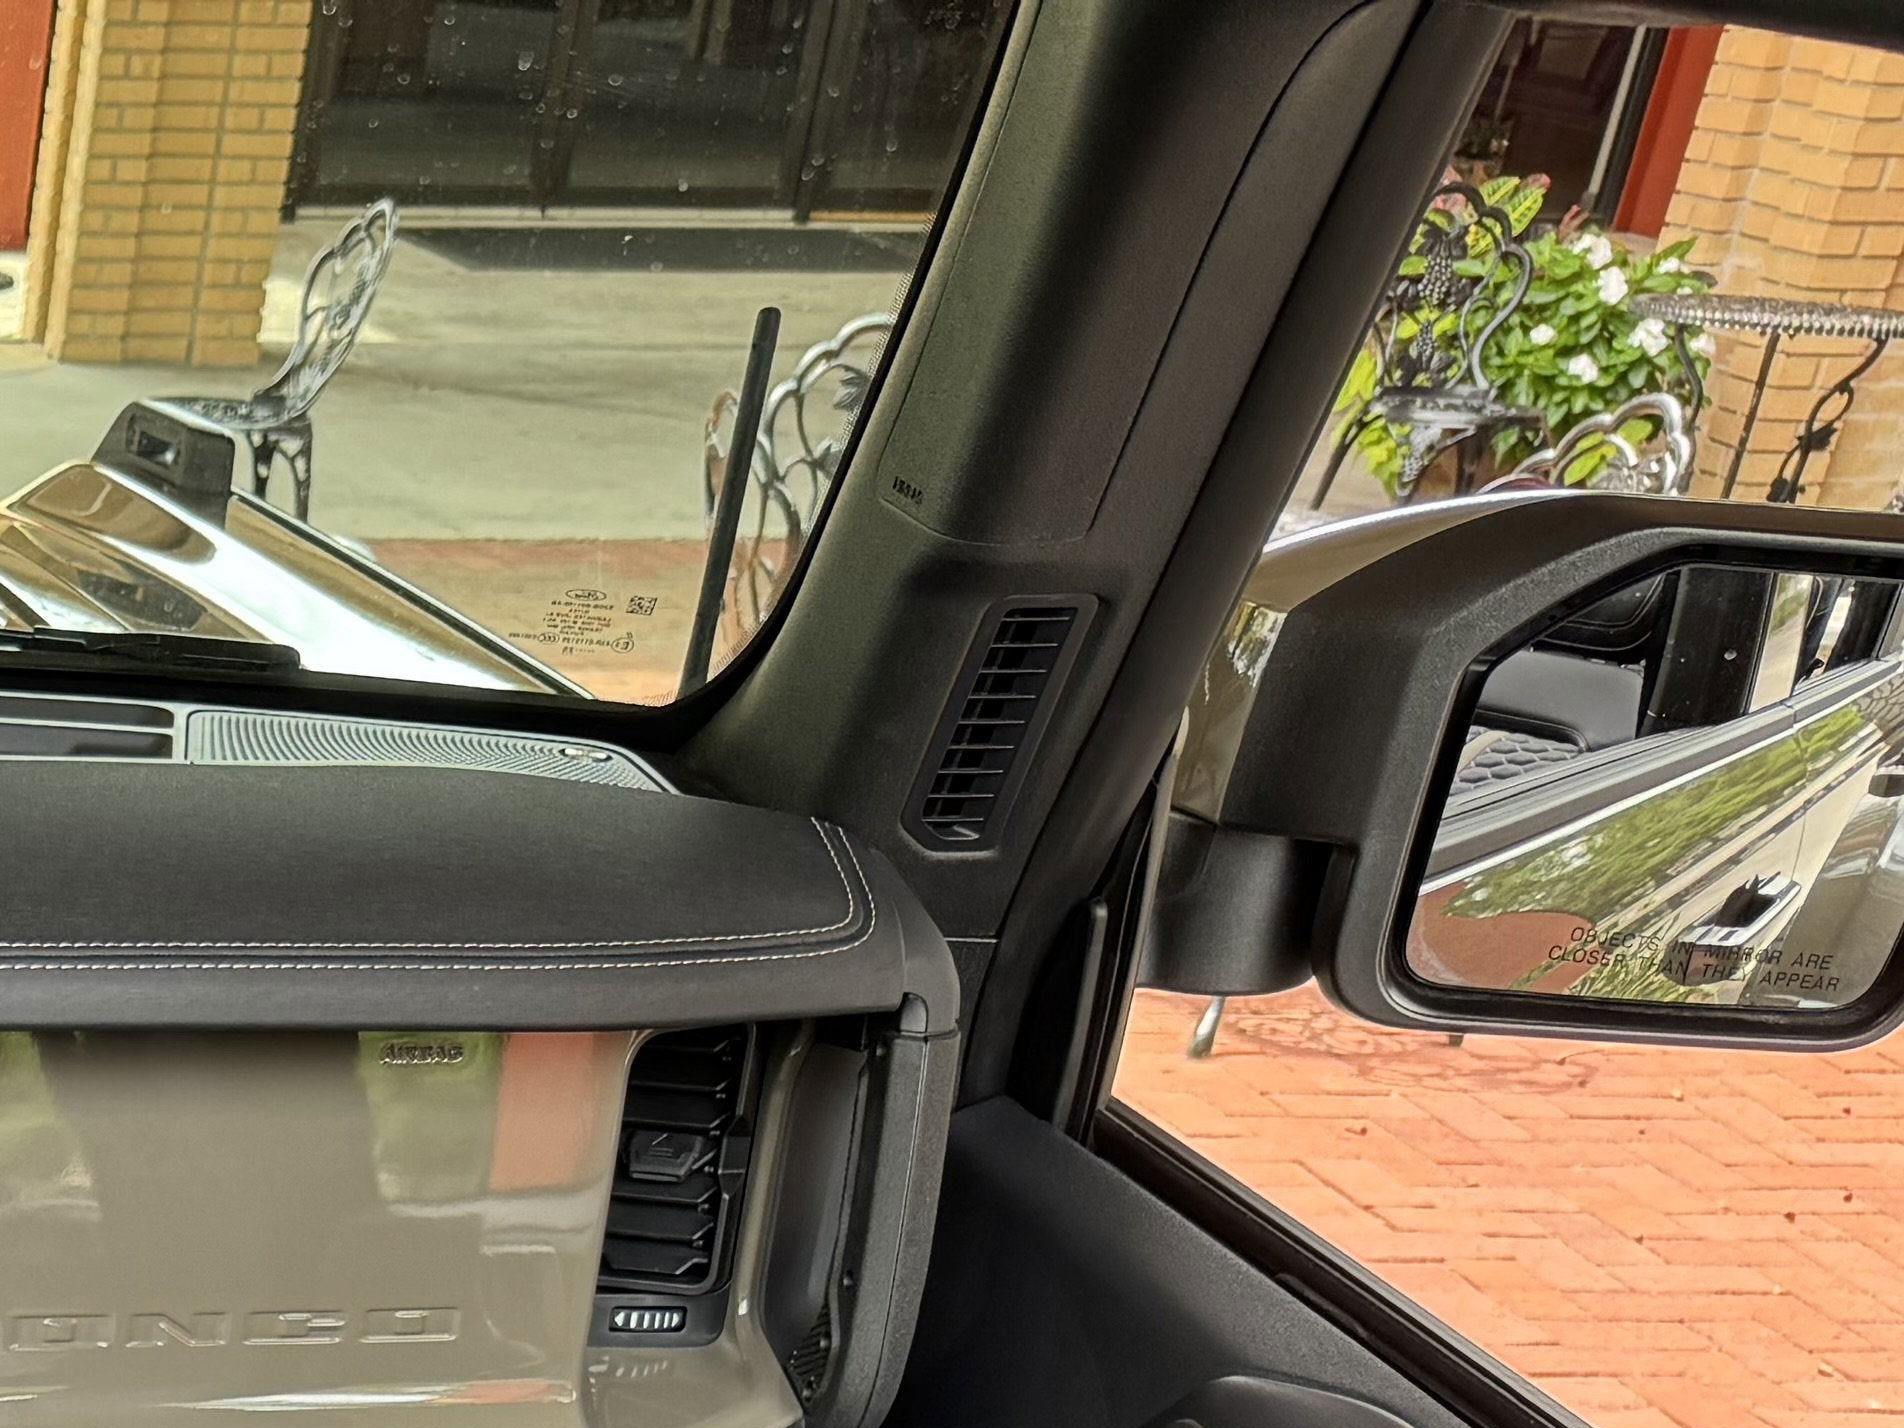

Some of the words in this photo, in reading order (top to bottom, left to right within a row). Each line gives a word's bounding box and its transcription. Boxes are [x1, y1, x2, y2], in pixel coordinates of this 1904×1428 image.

[1548, 945, 1626, 967] CLOSER
[1638, 955, 1688, 977] THAN
[1702, 963, 1748, 982] THEY
[1759, 970, 1839, 992] APPEAR
[1570, 927, 1661, 951] OBJECTS
[1672, 941, 1692, 955] IN
[1704, 945, 1783, 965] MIRROR
[1792, 953, 1834, 970] ARE
[378, 1042, 465, 1065] AIRBAG
